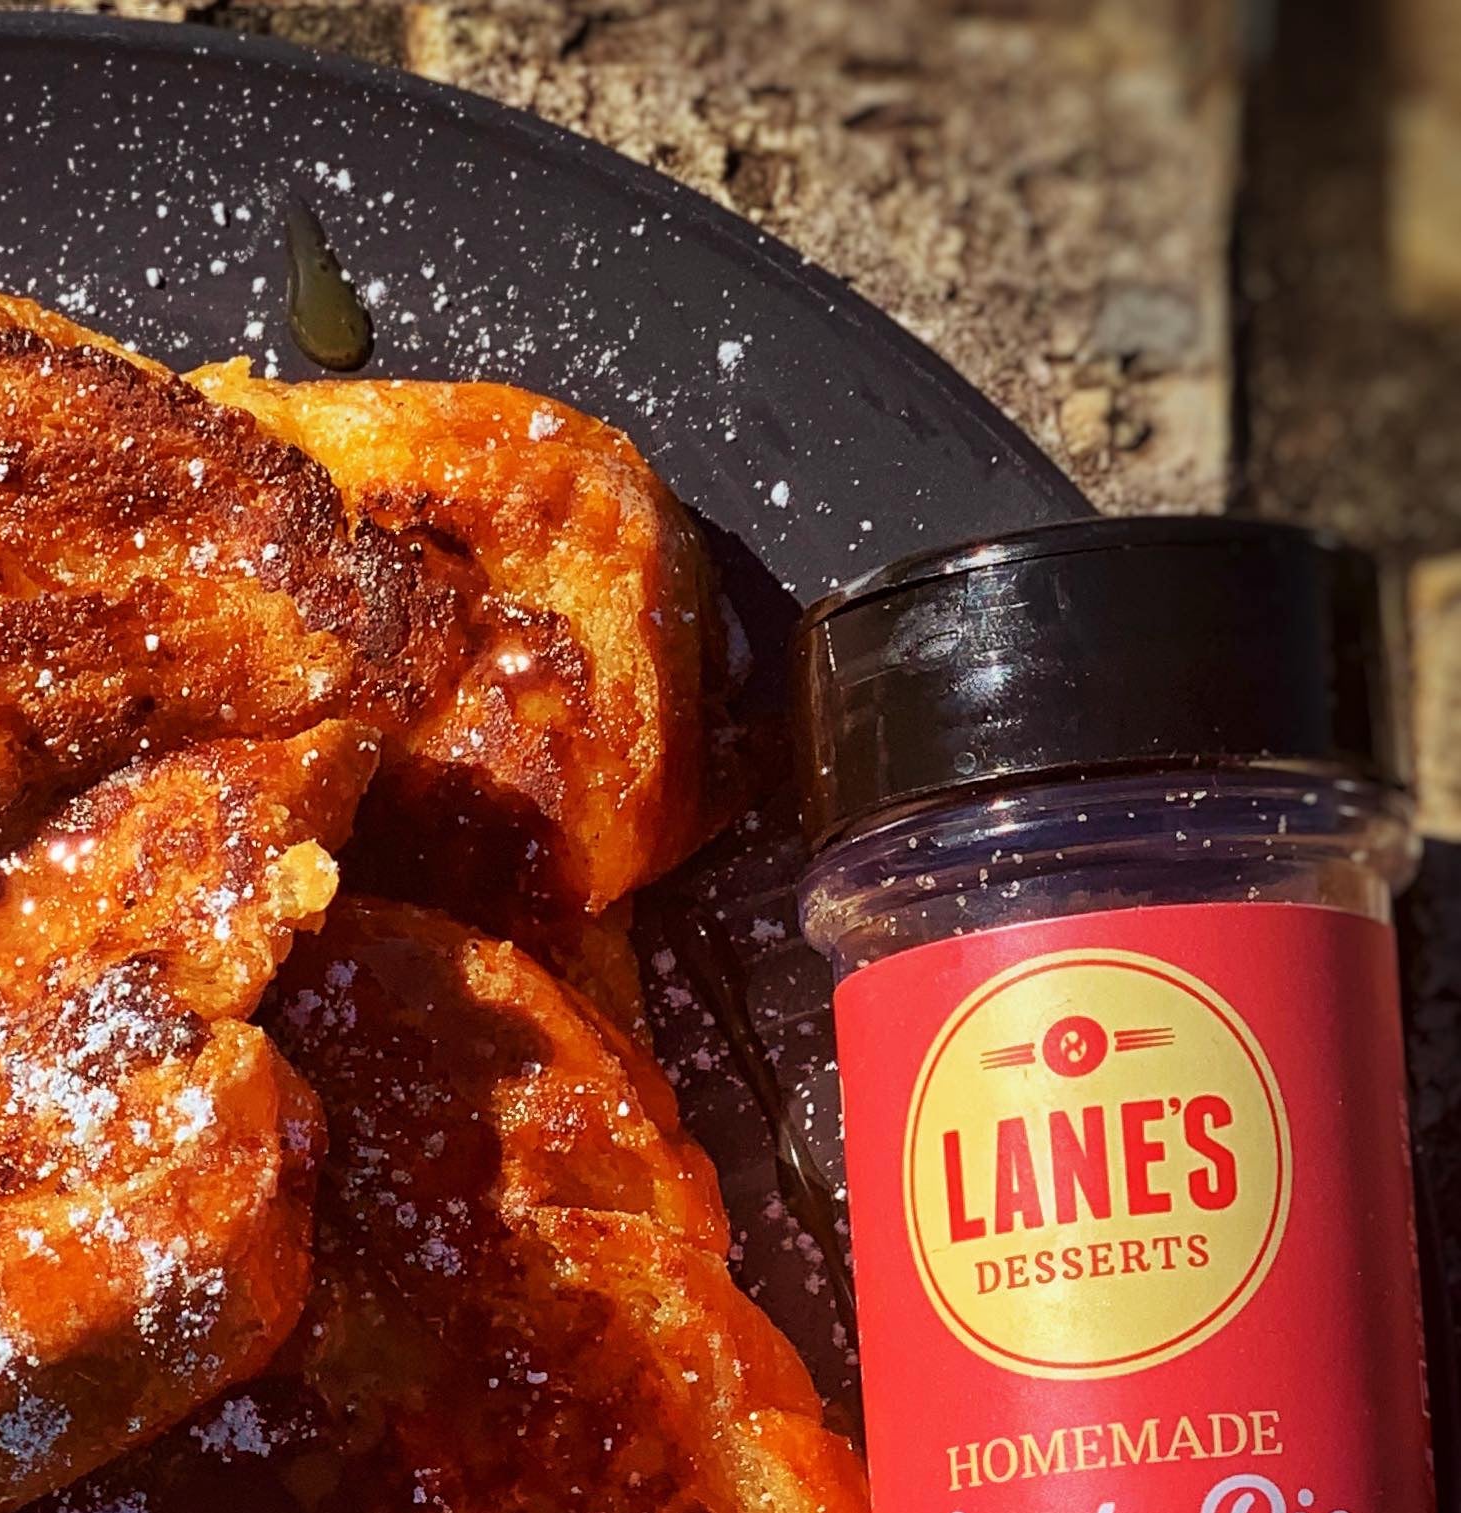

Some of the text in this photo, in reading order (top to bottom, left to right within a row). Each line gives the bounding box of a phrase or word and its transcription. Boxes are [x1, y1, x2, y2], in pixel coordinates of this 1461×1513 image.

[943, 1094, 1238, 1244] LANE'S
[975, 1234, 1210, 1295] DESSERTS
[946, 1410, 1284, 1492] HOMEMADE
